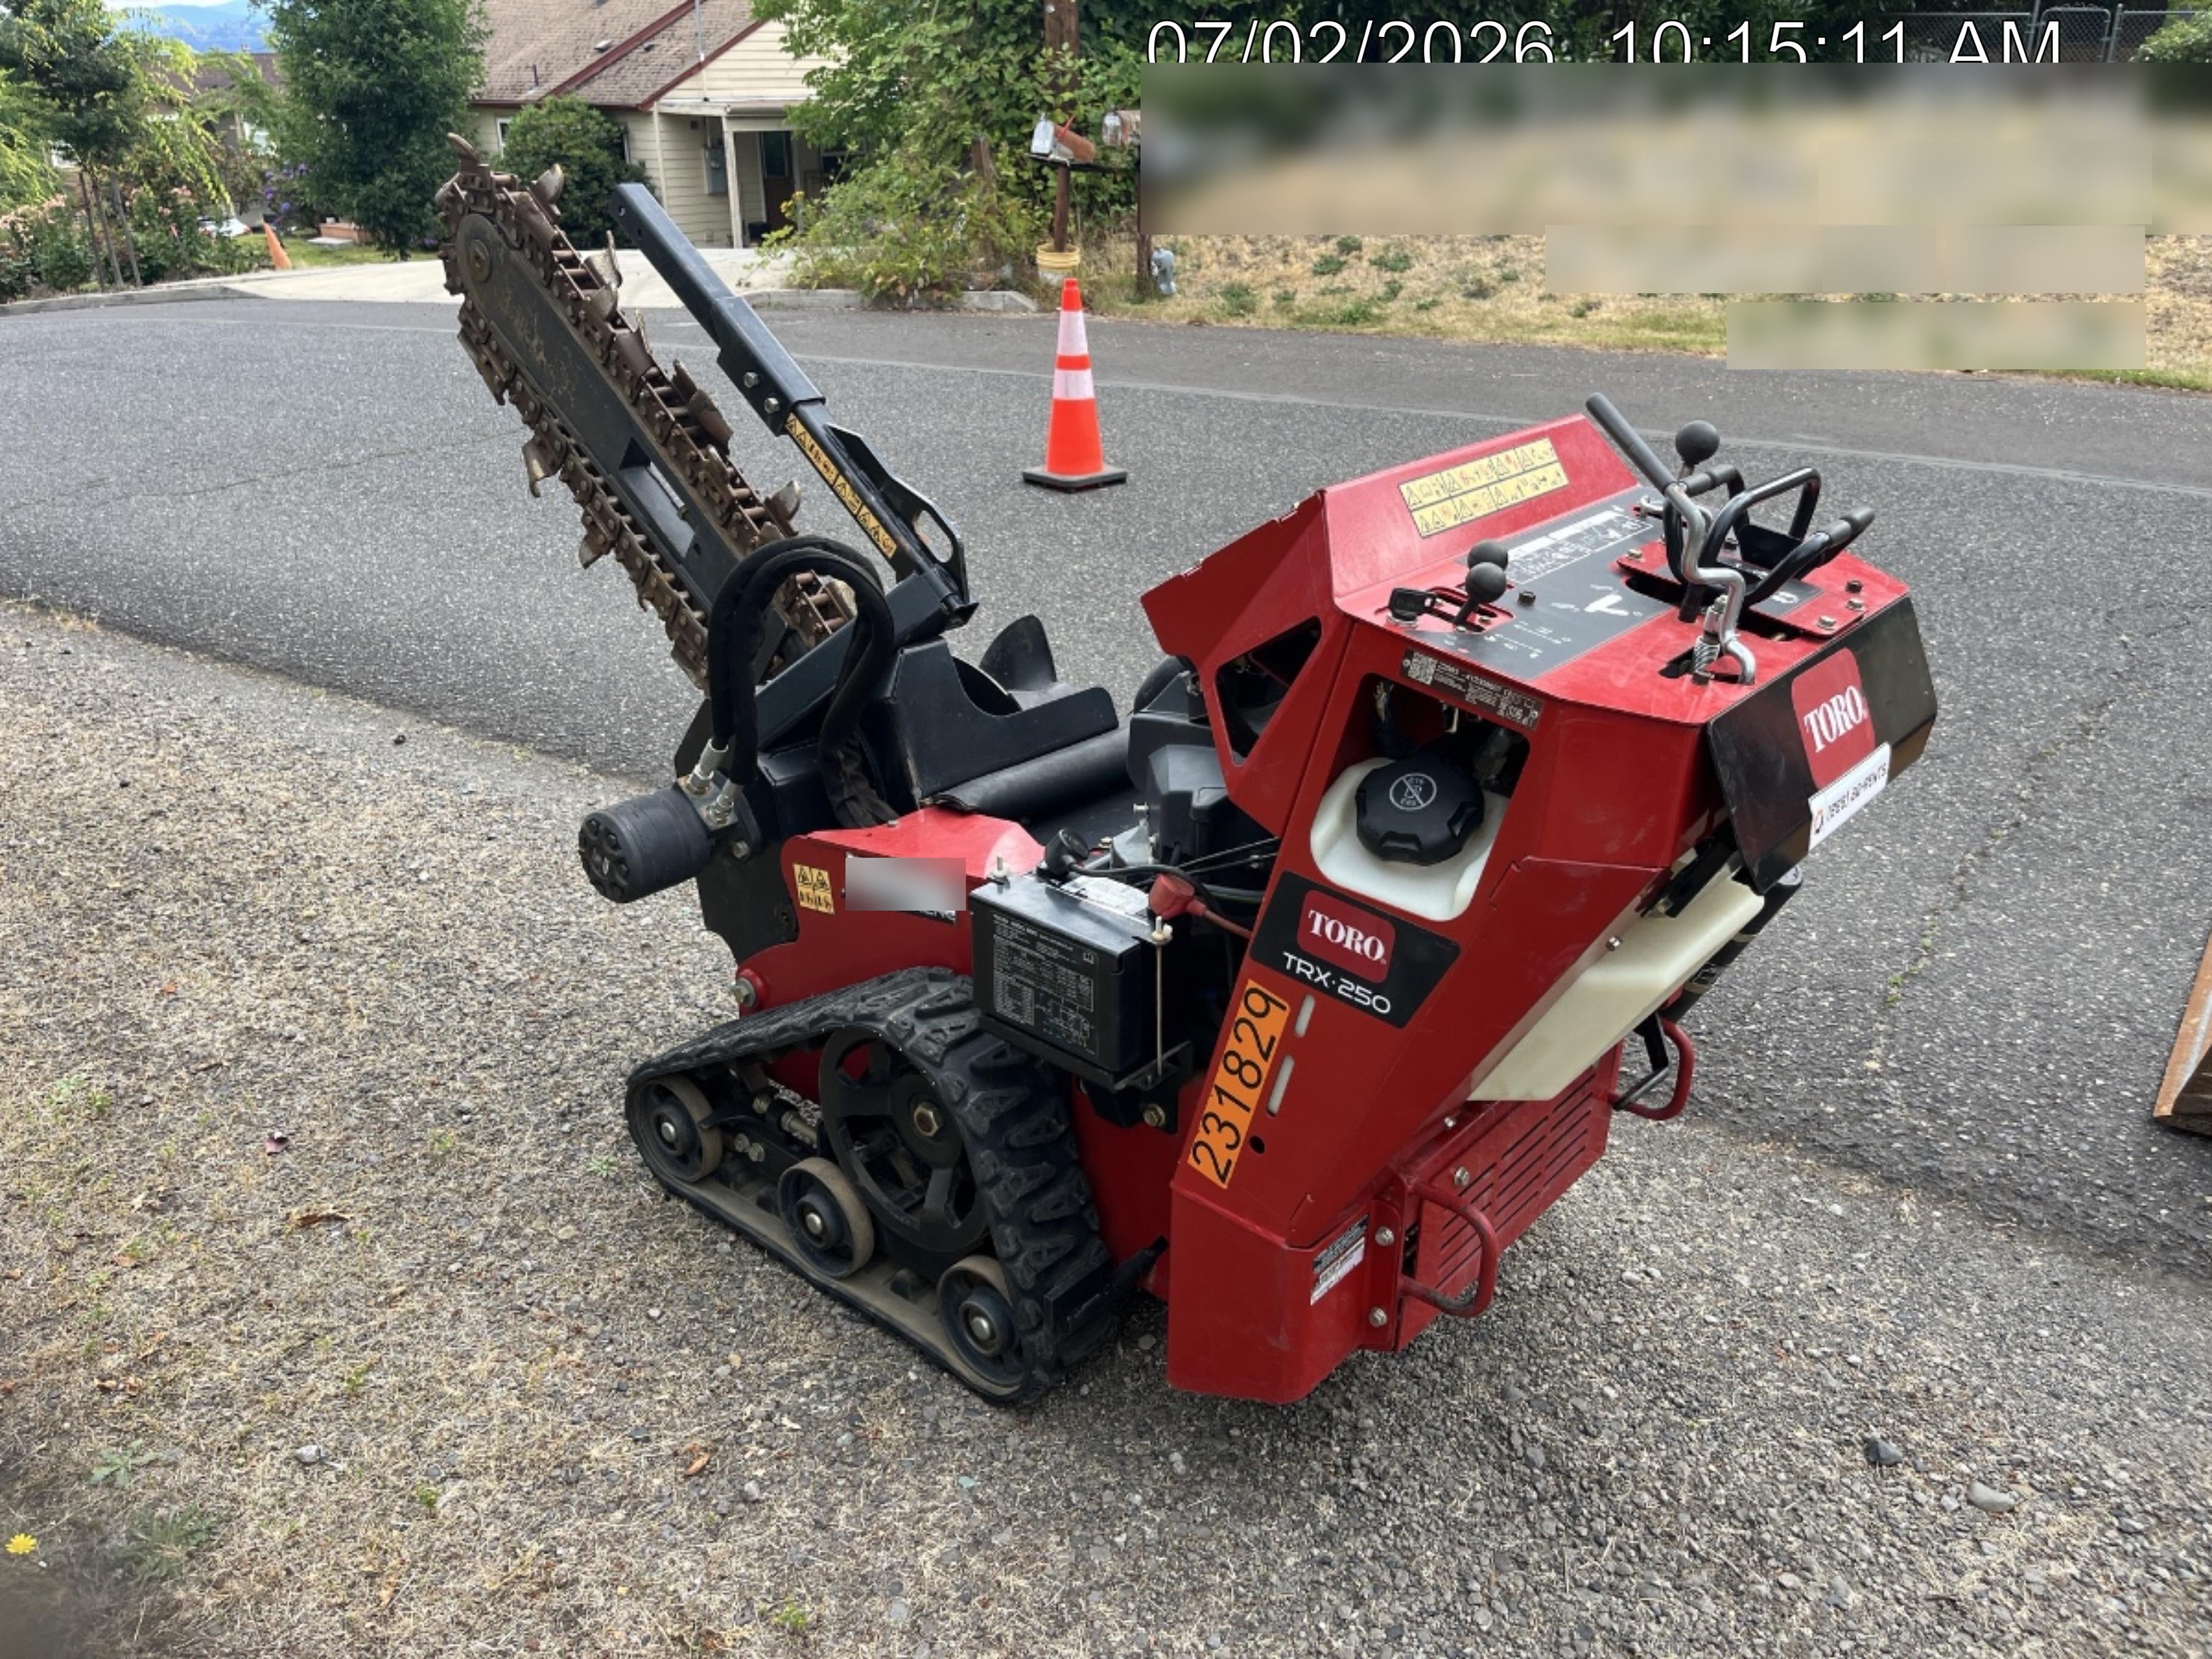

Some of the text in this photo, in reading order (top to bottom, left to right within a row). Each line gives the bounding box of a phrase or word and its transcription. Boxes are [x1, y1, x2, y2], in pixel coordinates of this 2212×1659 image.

[1803, 686, 1864, 753] TORO
[1309, 909, 1385, 961] TORO
[1193, 987, 1287, 1184] 231829
